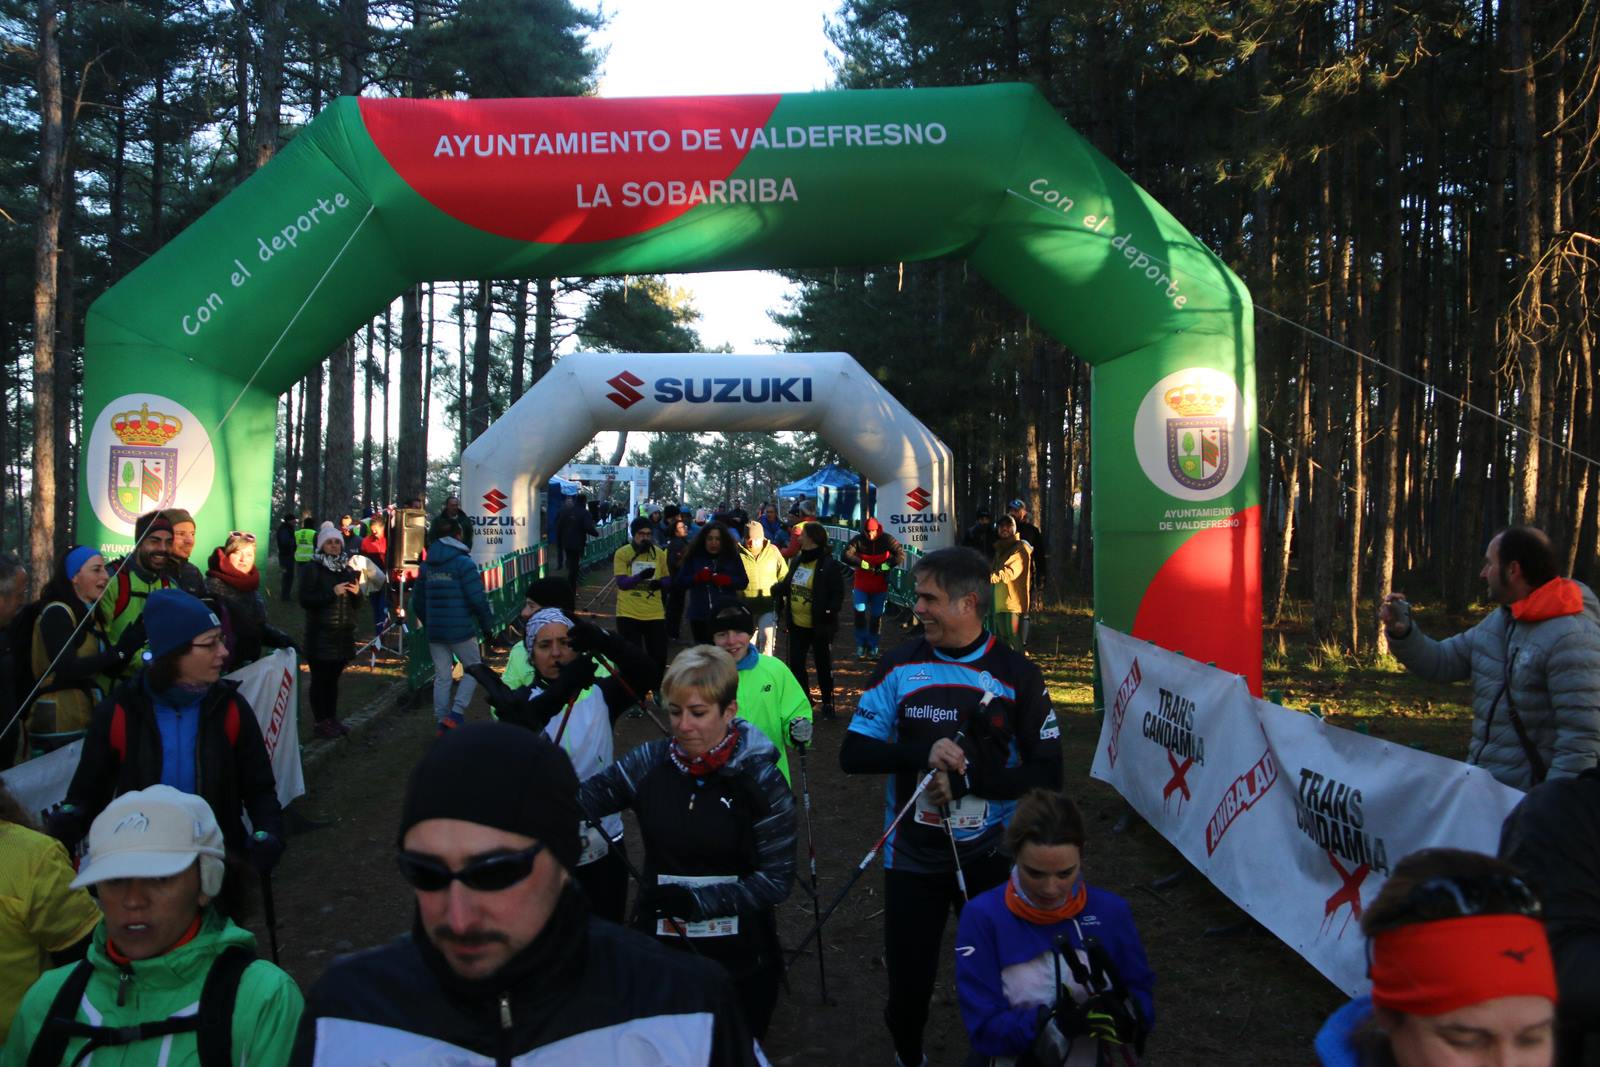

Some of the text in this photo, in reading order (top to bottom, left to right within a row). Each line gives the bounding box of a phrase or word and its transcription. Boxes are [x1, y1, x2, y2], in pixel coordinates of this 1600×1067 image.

[433, 122, 947, 158] AYUNTAMIENTO DE VALDEFRESNO
[576, 177, 799, 208] LA SOBARRIBA
[1029, 179, 1187, 309] Con el deporte
[183, 192, 350, 336] Con el deporte
[653, 377, 813, 404] SUZUKI
[469, 516, 526, 527] SUZUKI
[890, 513, 946, 524] SUZUKI
[1159, 519, 1239, 531] DE VALDEFRESNO
[1164, 507, 1235, 518] AYUNTAMIENTO
[907, 525, 928, 533] SERNA
[904, 704, 958, 722] intelligent
[1158, 687, 1196, 731] TRANS
[1142, 711, 1205, 767] CANDAMIA
[1299, 767, 1364, 829] TRANS
